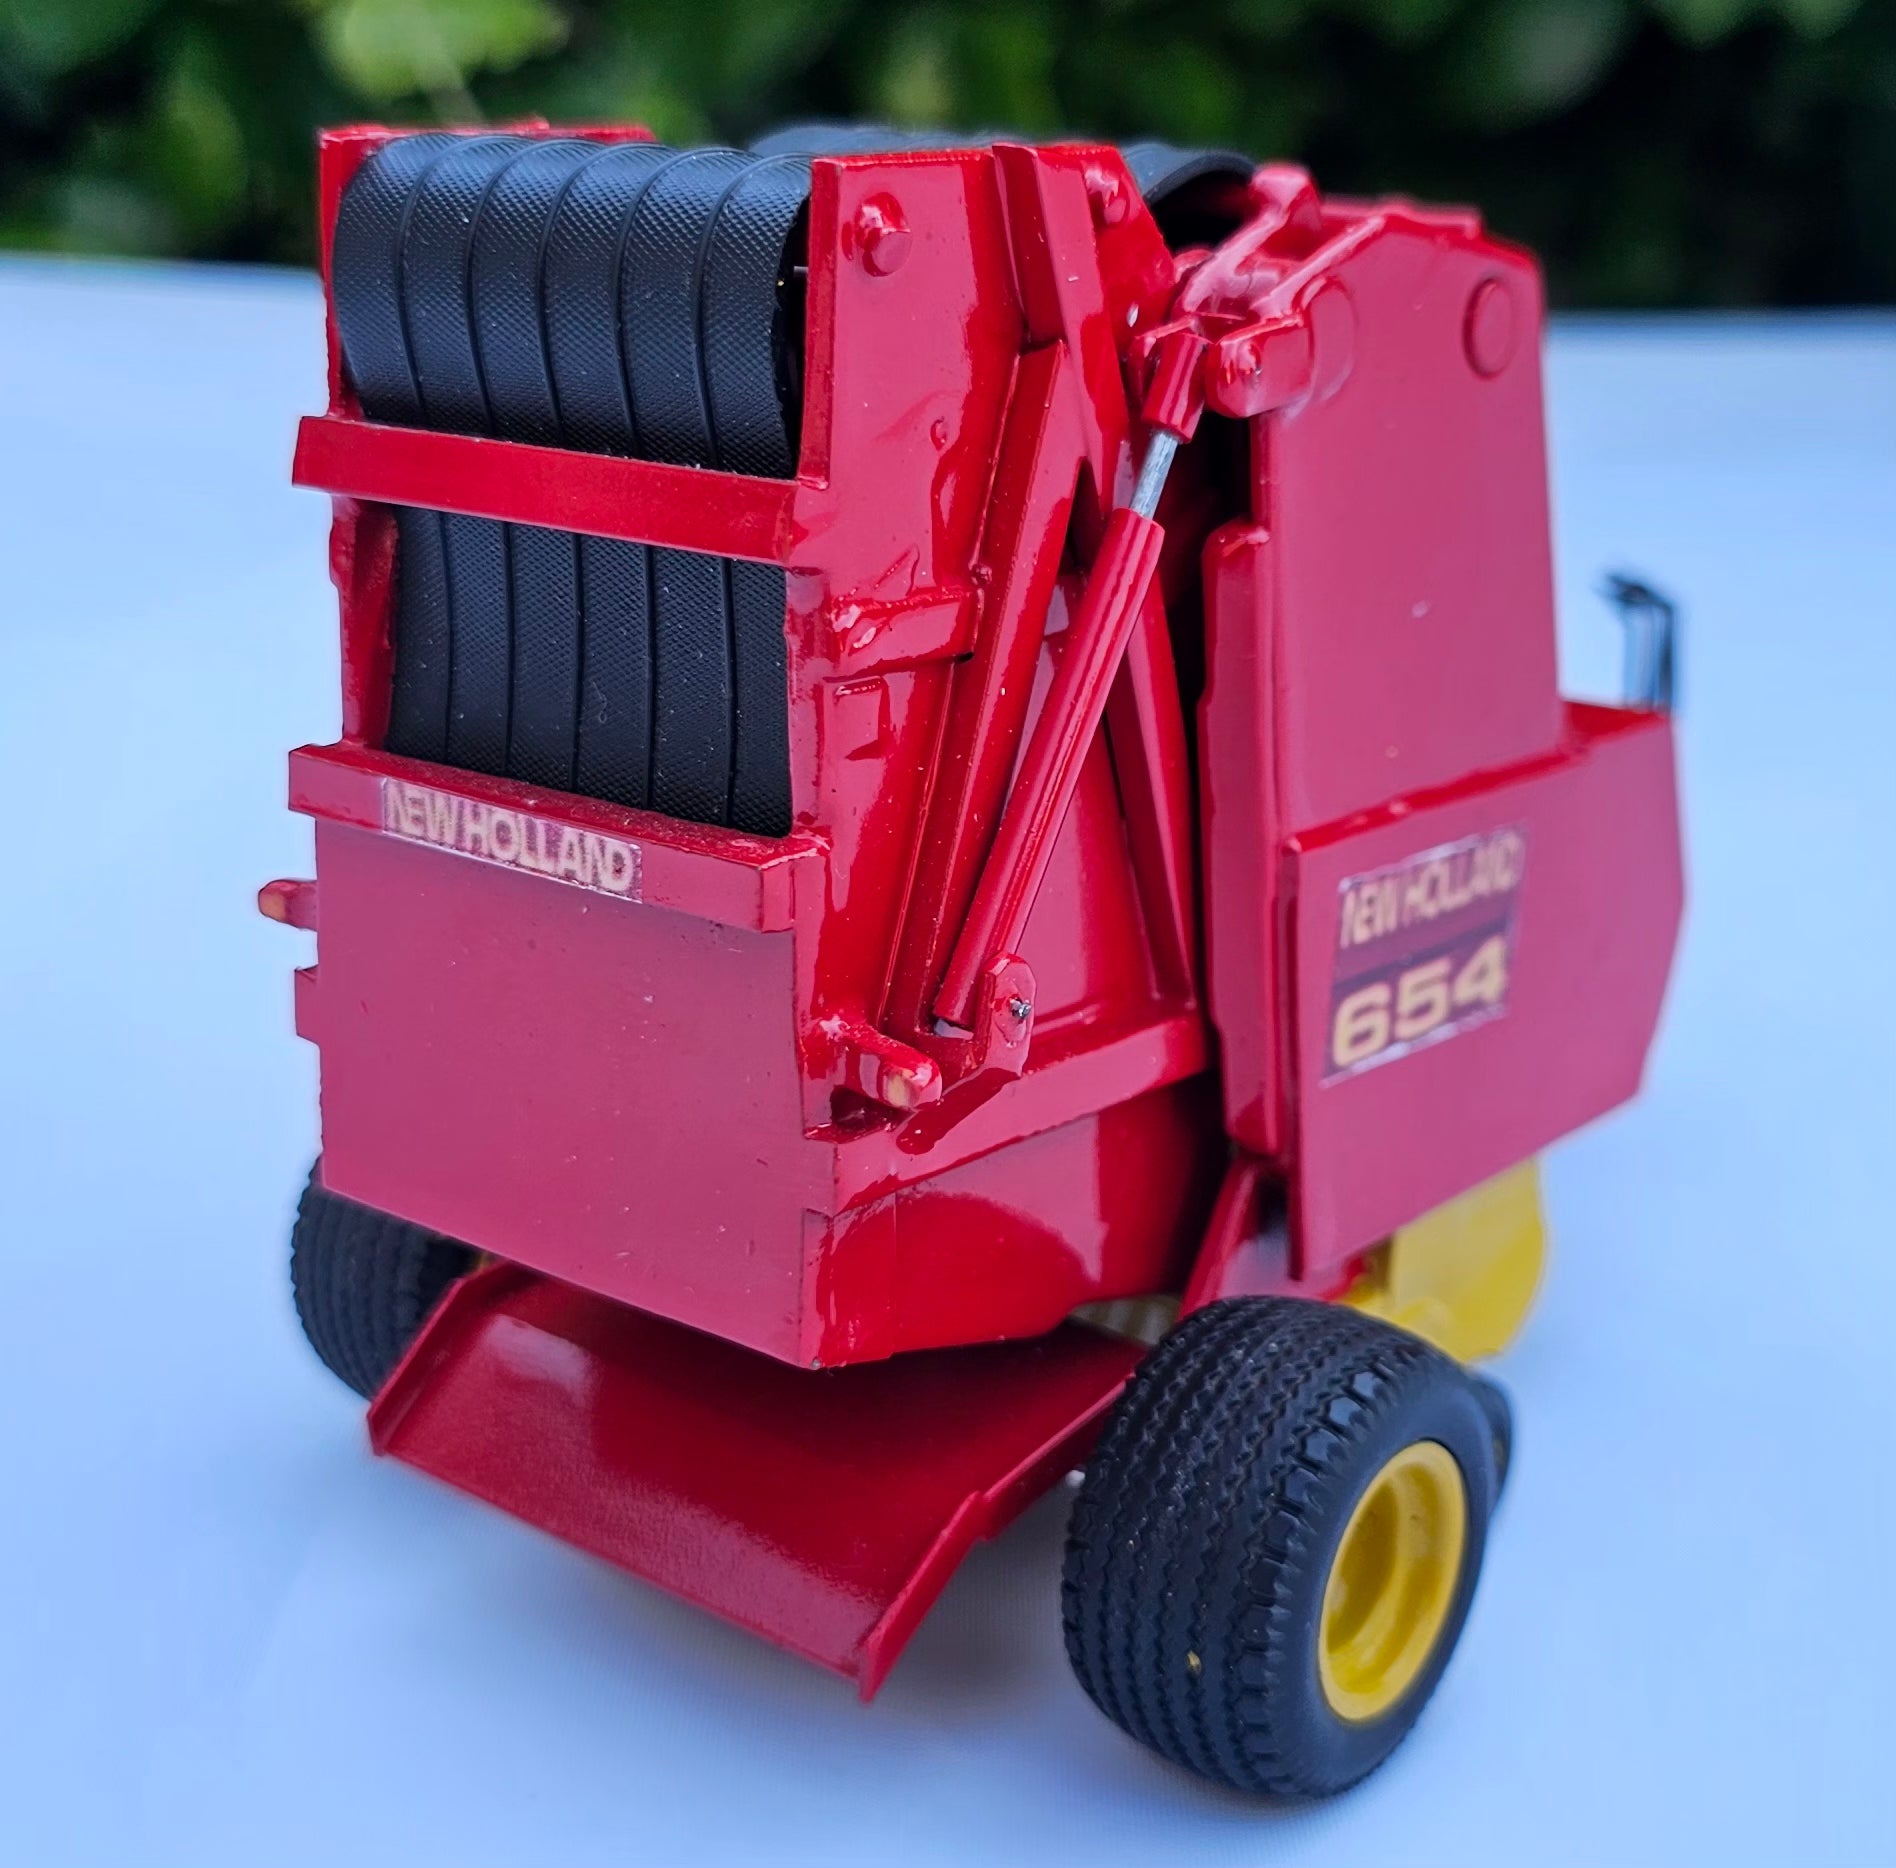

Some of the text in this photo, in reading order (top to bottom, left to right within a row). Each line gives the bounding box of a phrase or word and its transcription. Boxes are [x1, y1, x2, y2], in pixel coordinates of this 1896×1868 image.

[386, 780, 634, 892] NEW HOLLAND
[1332, 935, 1506, 1066] 654
